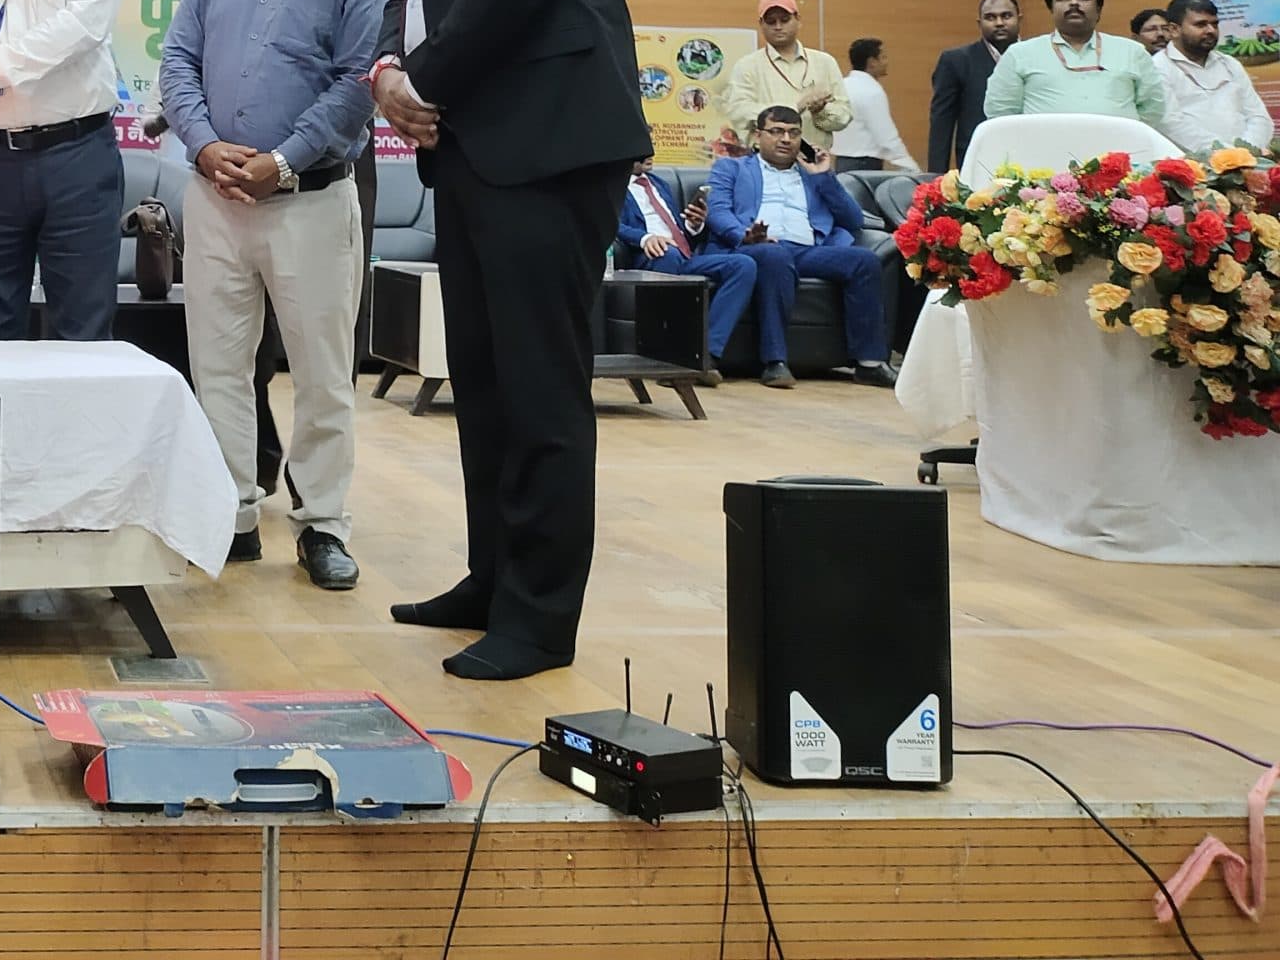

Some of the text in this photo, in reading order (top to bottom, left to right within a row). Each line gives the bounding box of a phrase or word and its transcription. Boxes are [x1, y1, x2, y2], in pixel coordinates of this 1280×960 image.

[920, 709, 936, 731] 6
[795, 731, 826, 739] 1000
[845, 766, 884, 776] QSC
